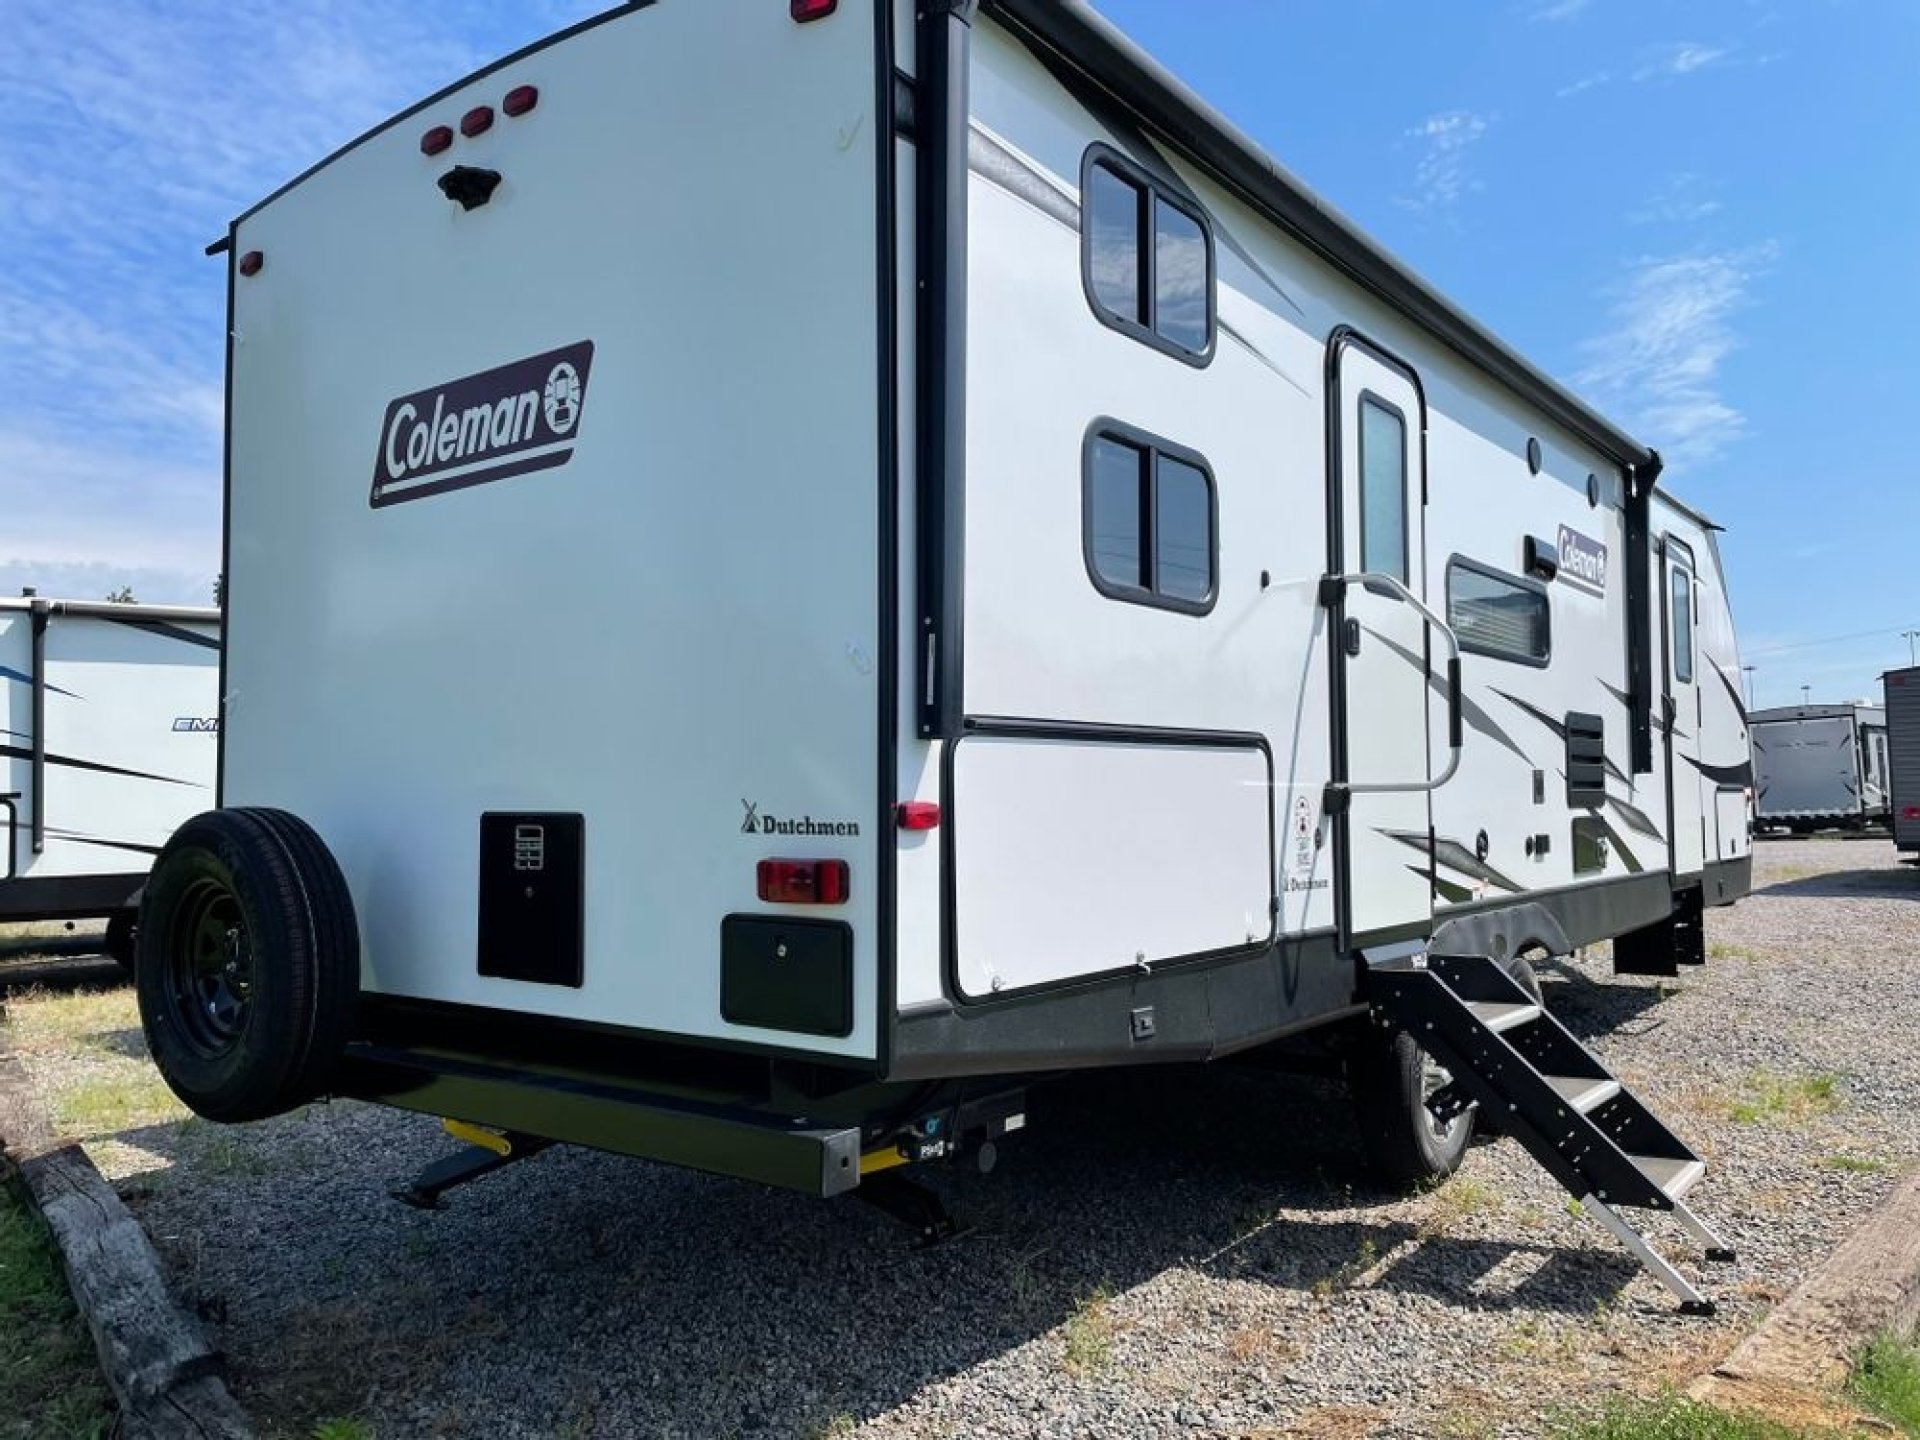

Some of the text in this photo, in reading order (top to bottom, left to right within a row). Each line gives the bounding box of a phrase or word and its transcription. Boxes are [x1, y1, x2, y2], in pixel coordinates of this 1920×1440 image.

[385, 390, 539, 478] Coleman
[1559, 528, 1598, 582] Coleman
[173, 718, 219, 731] EM
[763, 815, 860, 836] Dutchmen
